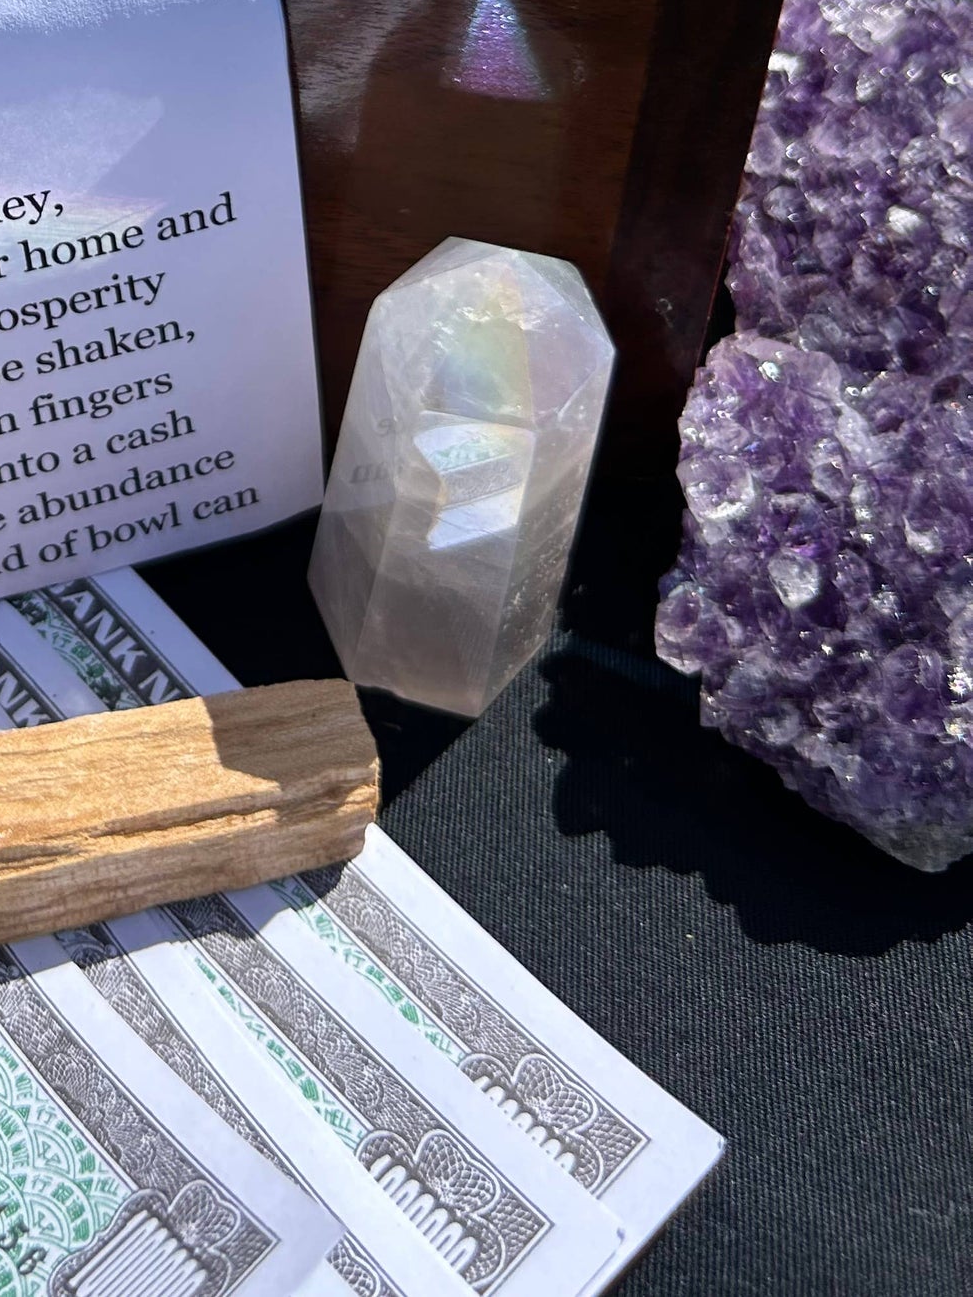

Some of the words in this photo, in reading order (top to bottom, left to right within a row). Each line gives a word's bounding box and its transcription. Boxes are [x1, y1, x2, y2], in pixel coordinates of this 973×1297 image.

[18, 226, 144, 272] home
[157, 191, 237, 241] and
[36, 321, 195, 374] shaken,
[29, 373, 172, 426] fingers
[73, 444, 95, 464] a
[107, 410, 195, 454] cash
[18, 451, 234, 524] abundance
[39, 533, 80, 562] of
[78, 502, 181, 550] bowl
[193, 488, 259, 520] can
[48, 582, 148, 678] ANK
